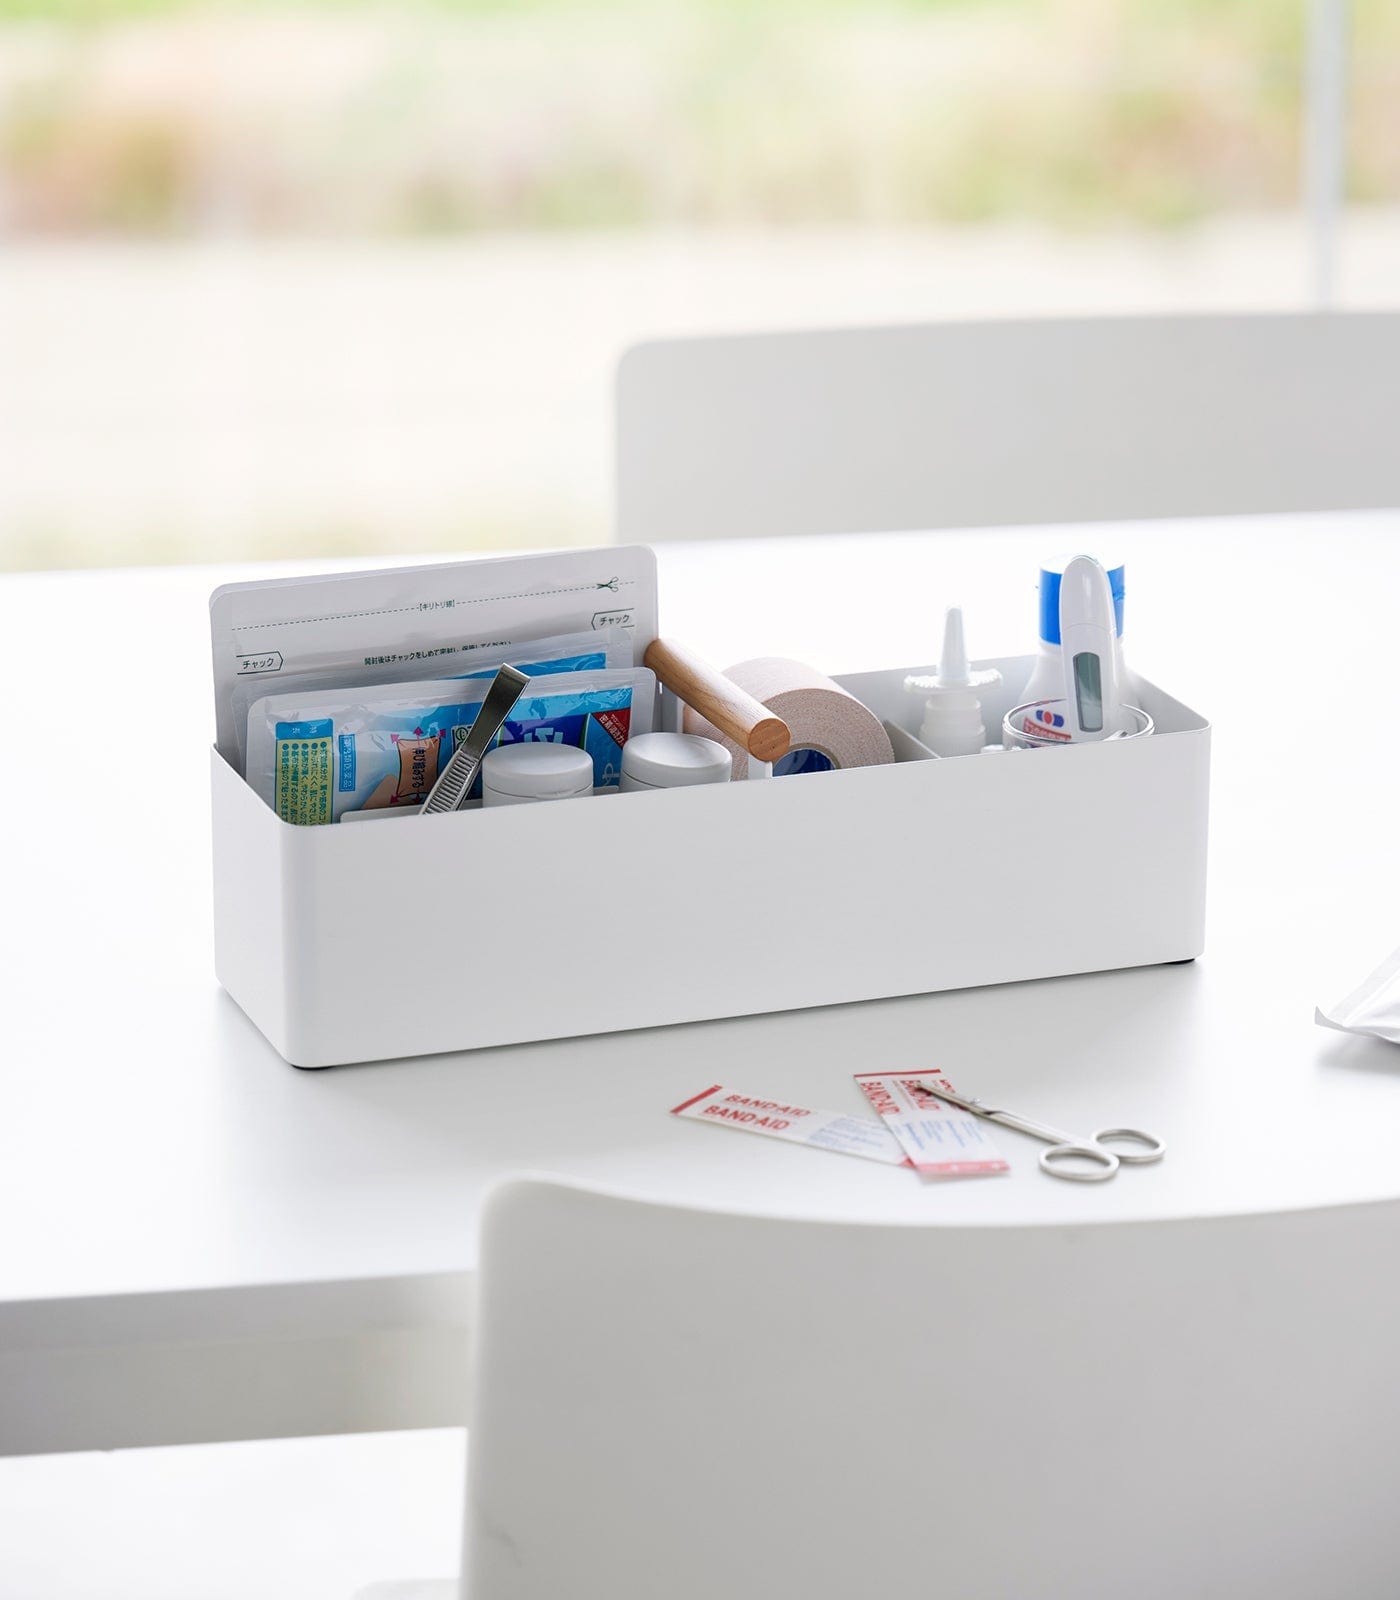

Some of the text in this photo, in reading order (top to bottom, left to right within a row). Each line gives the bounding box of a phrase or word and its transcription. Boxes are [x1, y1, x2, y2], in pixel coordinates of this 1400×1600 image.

[600, 614, 630, 626] チャック
[242, 658, 274, 670] チャック
[702, 1104, 792, 1131] BAND-AID
